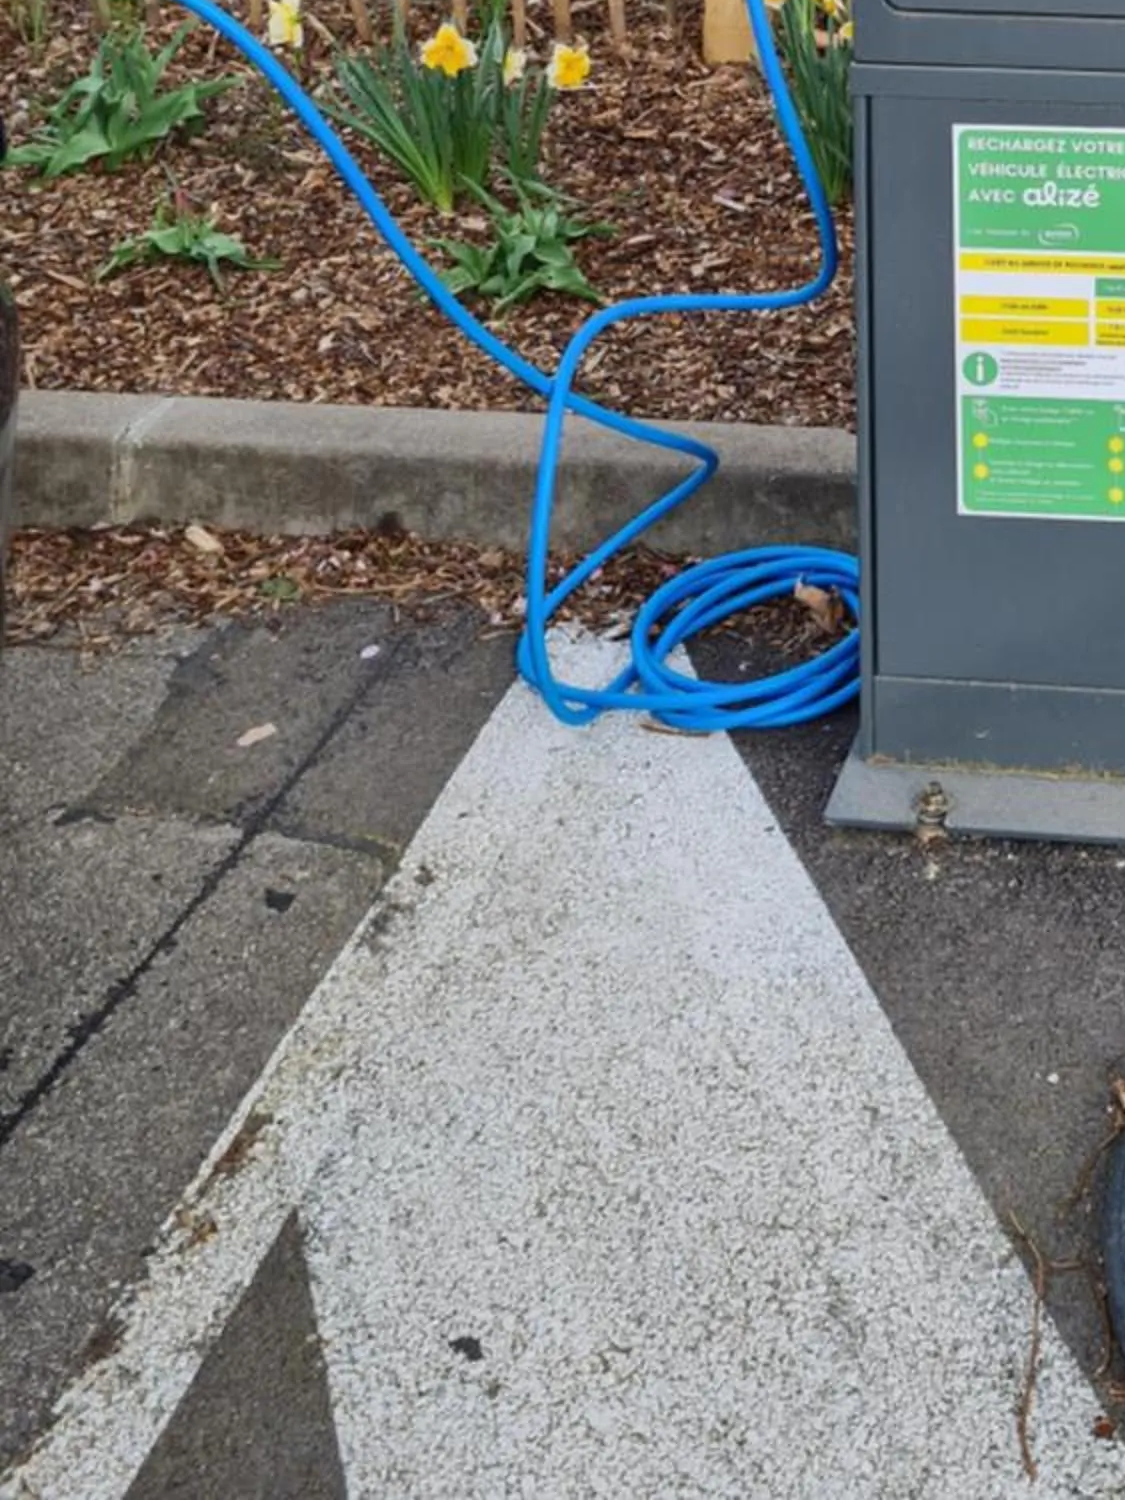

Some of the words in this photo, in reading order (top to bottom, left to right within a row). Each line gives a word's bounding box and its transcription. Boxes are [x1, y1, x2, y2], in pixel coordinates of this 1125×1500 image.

[967, 137, 1067, 153] RECHARGEZ
[1071, 140, 1125, 155] VOTRE
[967, 160, 1047, 178] VÉHICULE
[968, 188, 1016, 203] AVEC
[1023, 180, 1101, 207] alizé
